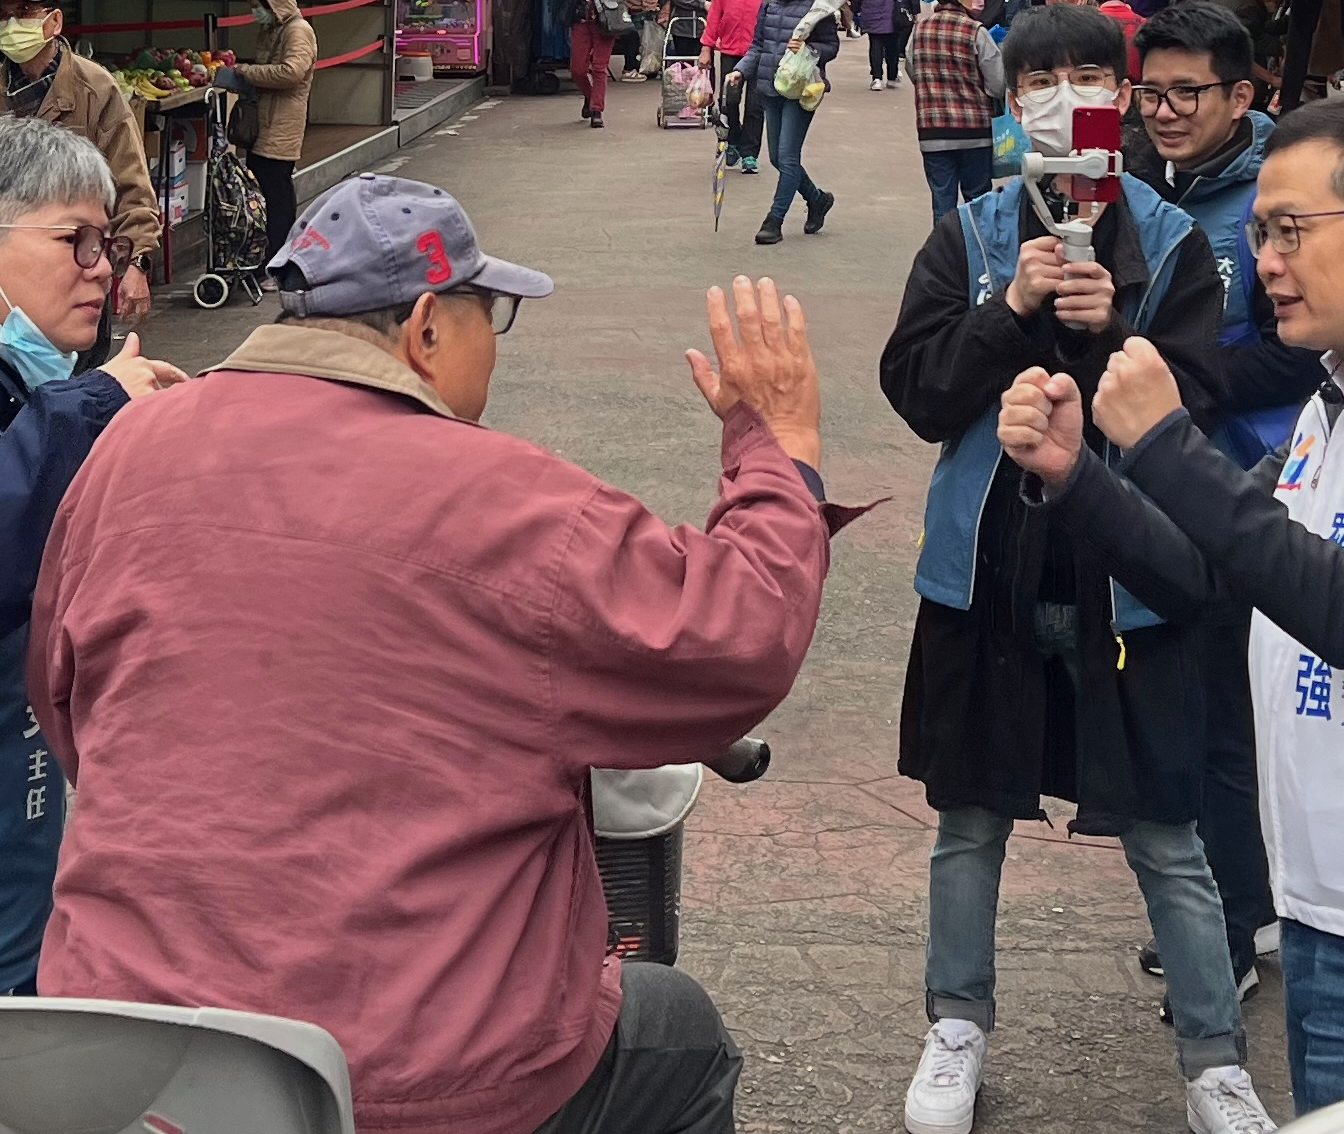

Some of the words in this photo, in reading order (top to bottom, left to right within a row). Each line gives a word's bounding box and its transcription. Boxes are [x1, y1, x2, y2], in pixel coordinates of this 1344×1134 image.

[416, 228, 452, 285] 3
[1217, 257, 1235, 310] 大
[1296, 654, 1334, 721] 強
